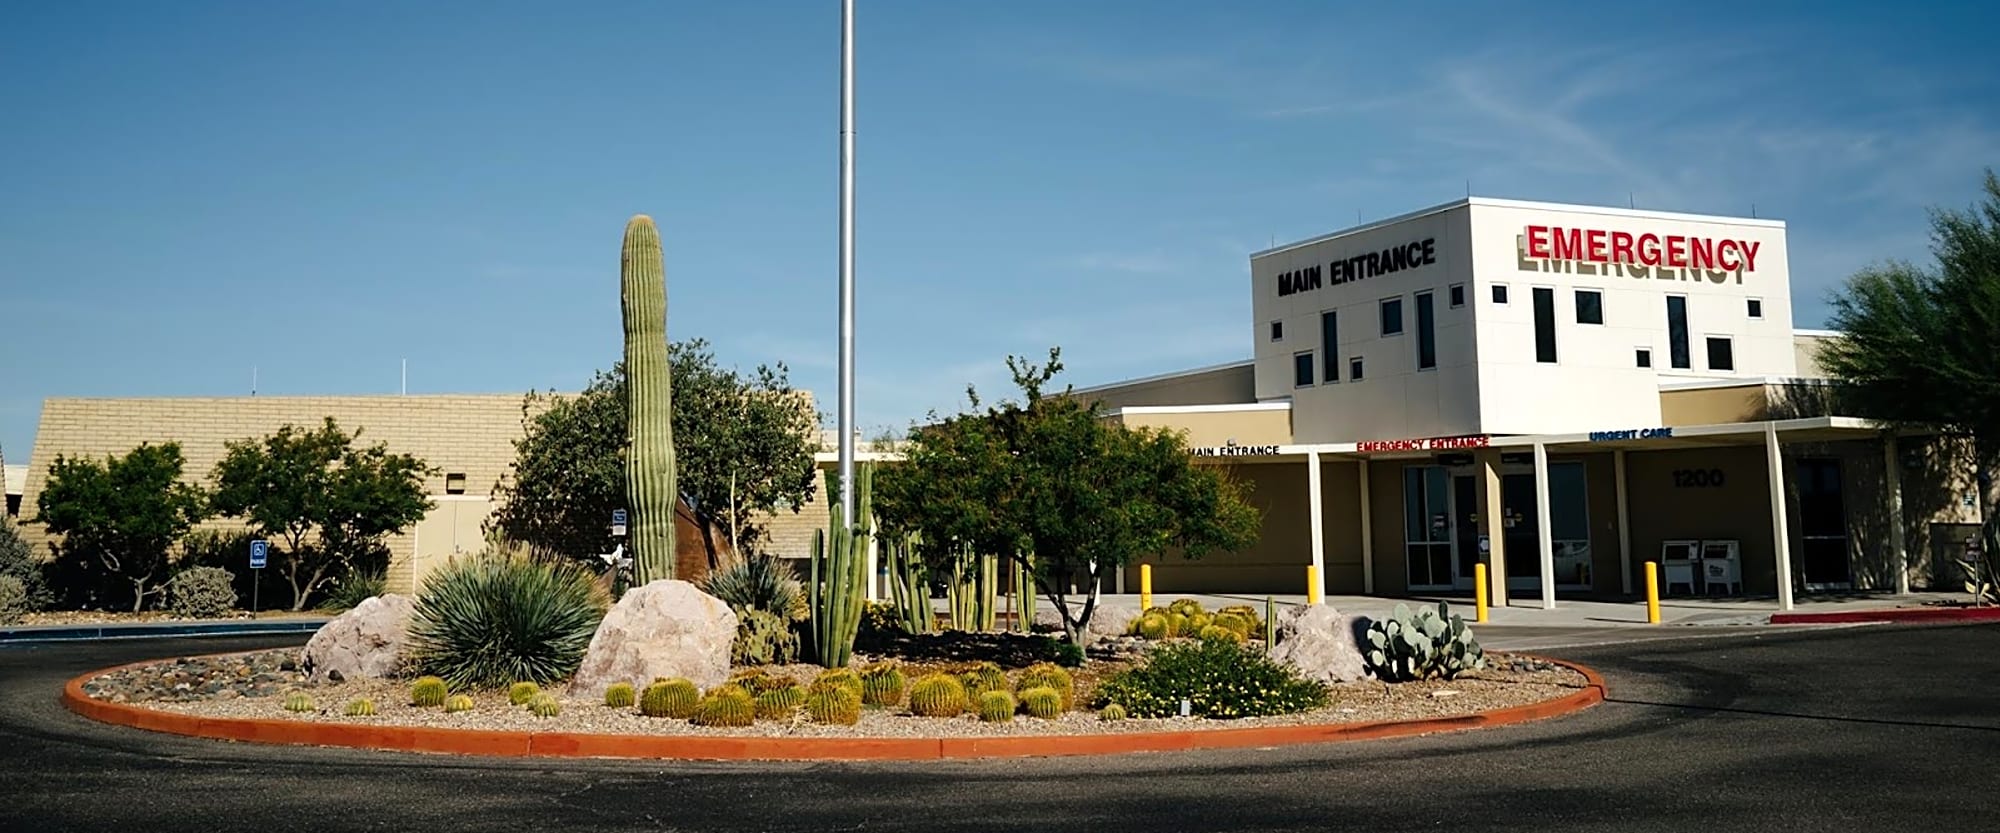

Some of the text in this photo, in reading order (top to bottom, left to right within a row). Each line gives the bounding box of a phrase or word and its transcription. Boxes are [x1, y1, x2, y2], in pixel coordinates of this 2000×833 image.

[1526, 225, 1761, 272] EMERGENCY
[1278, 238, 1436, 297] MAIN ENTRANCE
[1356, 435, 1489, 452] EMERGENCY ENTRANCE
[1589, 427, 1673, 442] URGENT CARE
[1187, 445, 1280, 457] MAIN ENTRANCE
[1673, 469, 1725, 488] 1200
